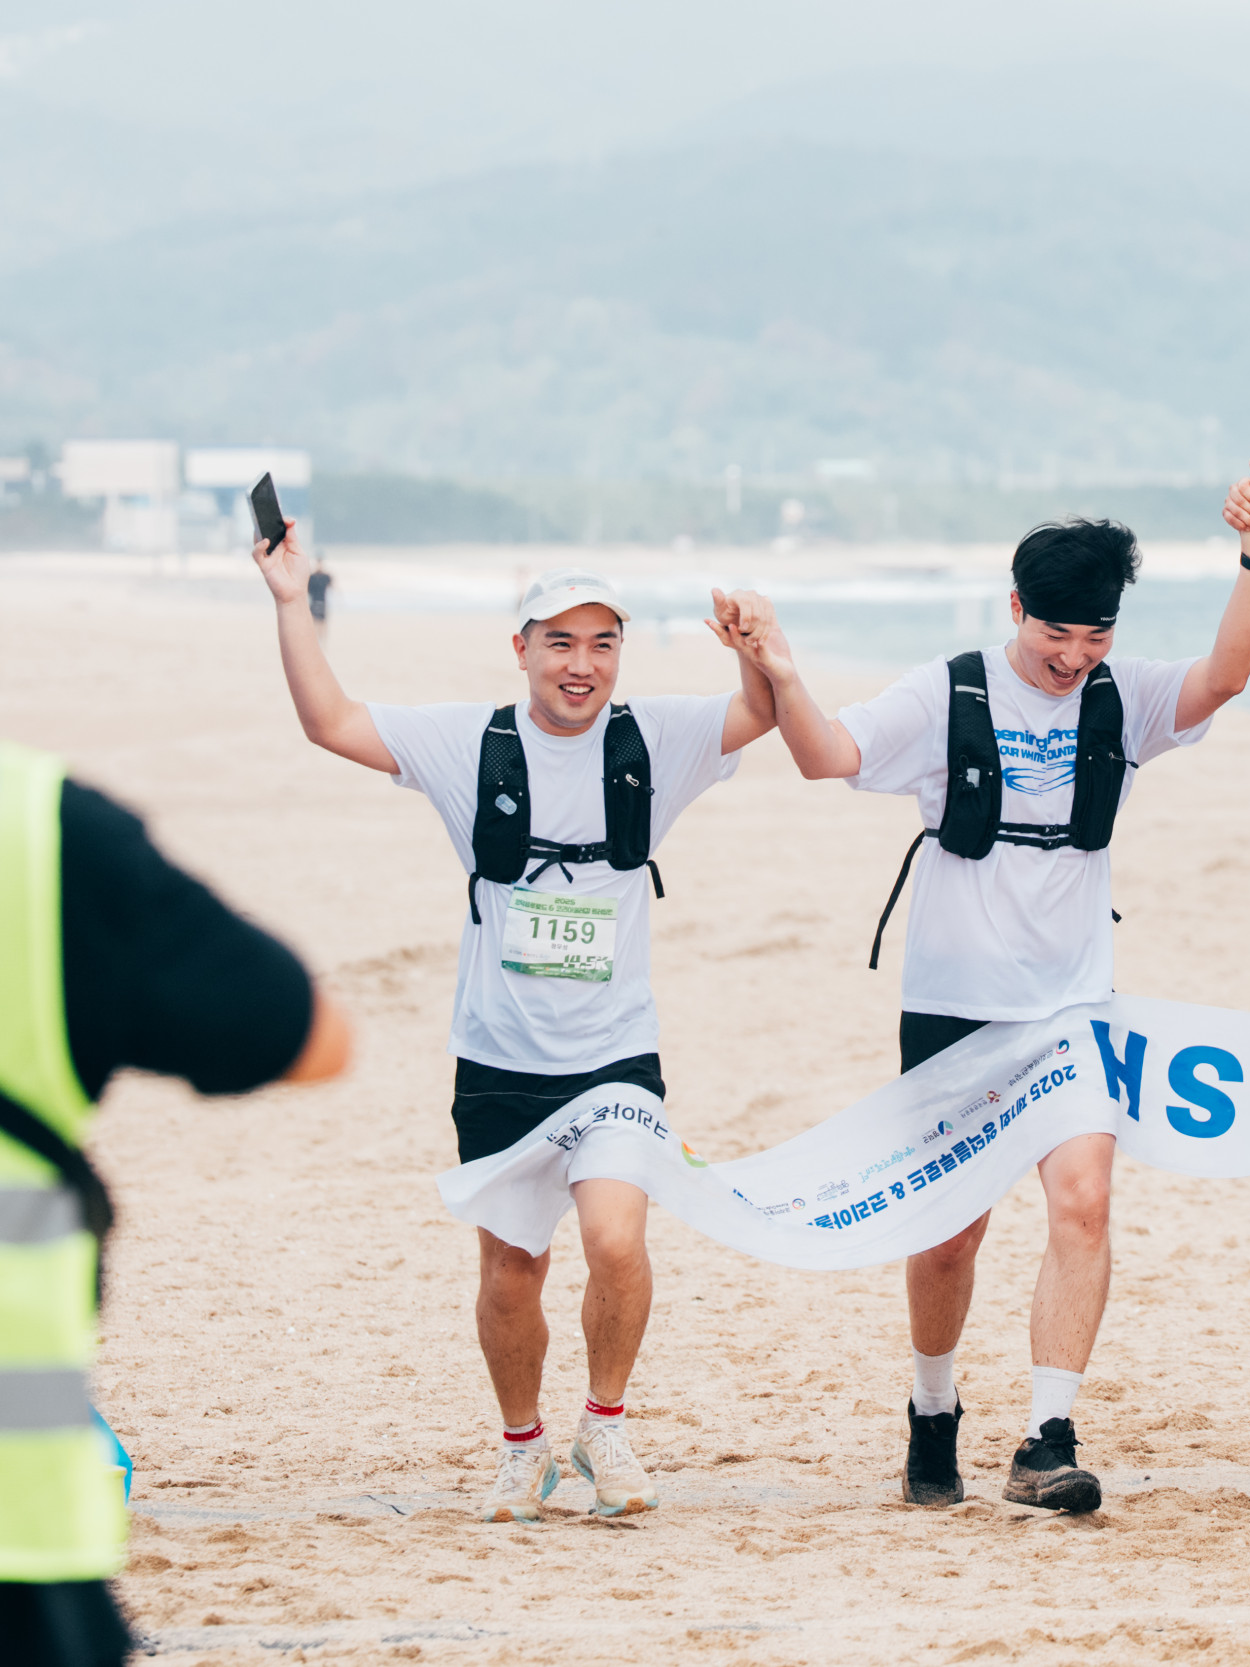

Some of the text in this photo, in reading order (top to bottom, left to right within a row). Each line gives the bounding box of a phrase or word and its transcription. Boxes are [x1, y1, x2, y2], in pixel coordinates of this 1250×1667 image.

[1047, 725, 1079, 745] Pro
[1020, 748, 1047, 764] WHITE
[1046, 744, 1078, 760] OUNTA
[554, 897, 576, 906] 2025
[529, 916, 596, 944] 1159
[563, 954, 609, 970] 14.5K
[1029, 1064, 1077, 1102] 2025
[999, 1093, 1028, 1132] 제1회
[907, 1121, 998, 1192] 영덕블루로드
[888, 1181, 906, 1200] &
[806, 1190, 888, 1230] 코리아둘
